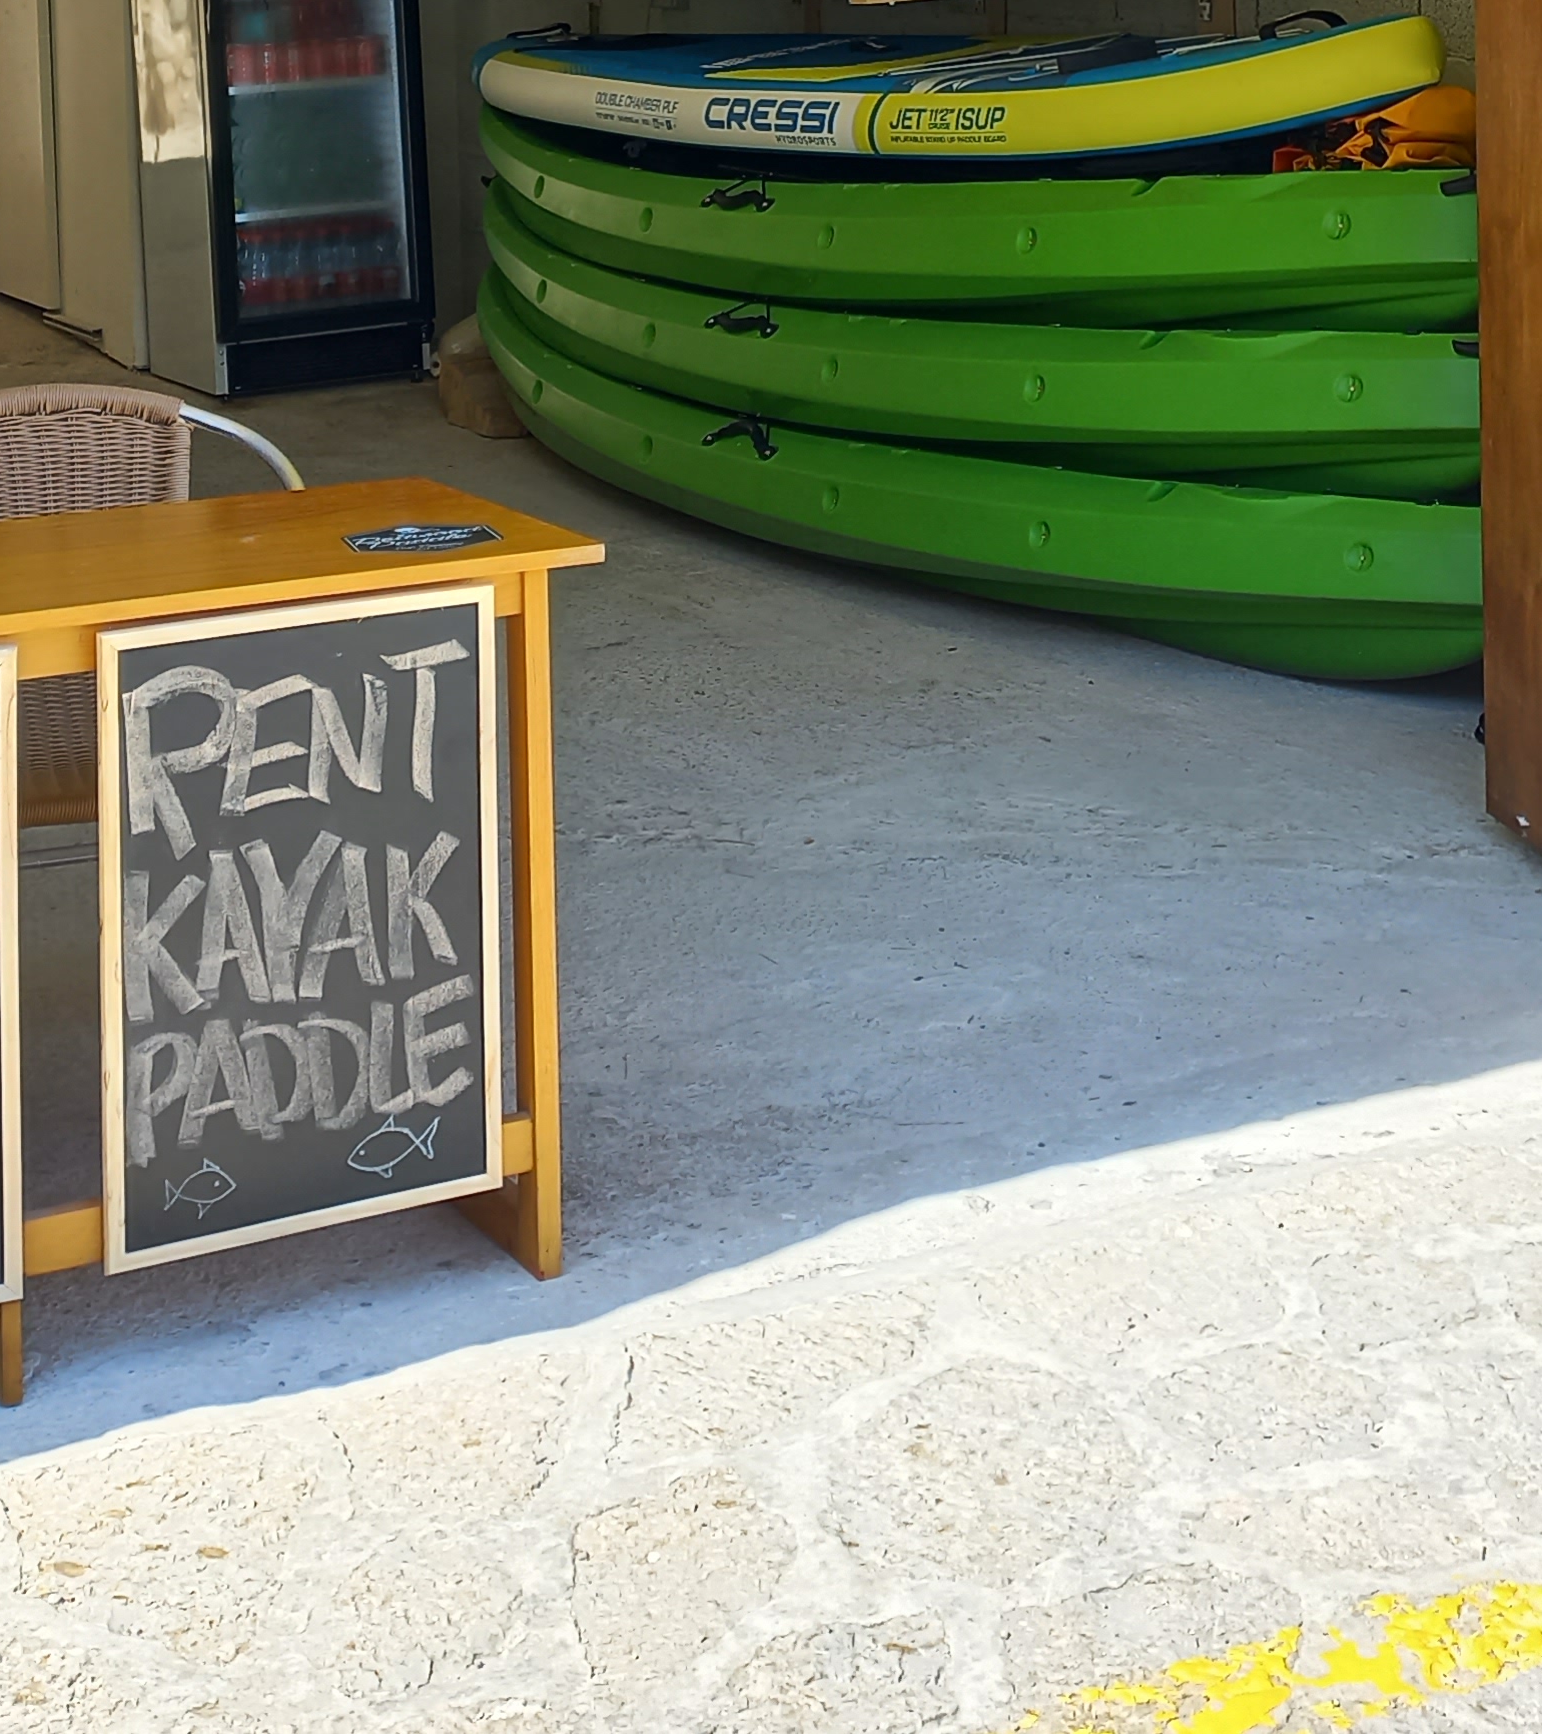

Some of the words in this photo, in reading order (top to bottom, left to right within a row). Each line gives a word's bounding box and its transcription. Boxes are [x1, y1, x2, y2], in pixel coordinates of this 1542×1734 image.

[703, 96, 841, 135] CRESSI
[774, 134, 837, 147] HYDROSPORTS
[889, 107, 929, 130] JET
[955, 106, 1006, 131] ISUP
[122, 639, 470, 861] RENT
[124, 829, 461, 1023] KAYAK
[125, 973, 474, 1168] PADDLE
